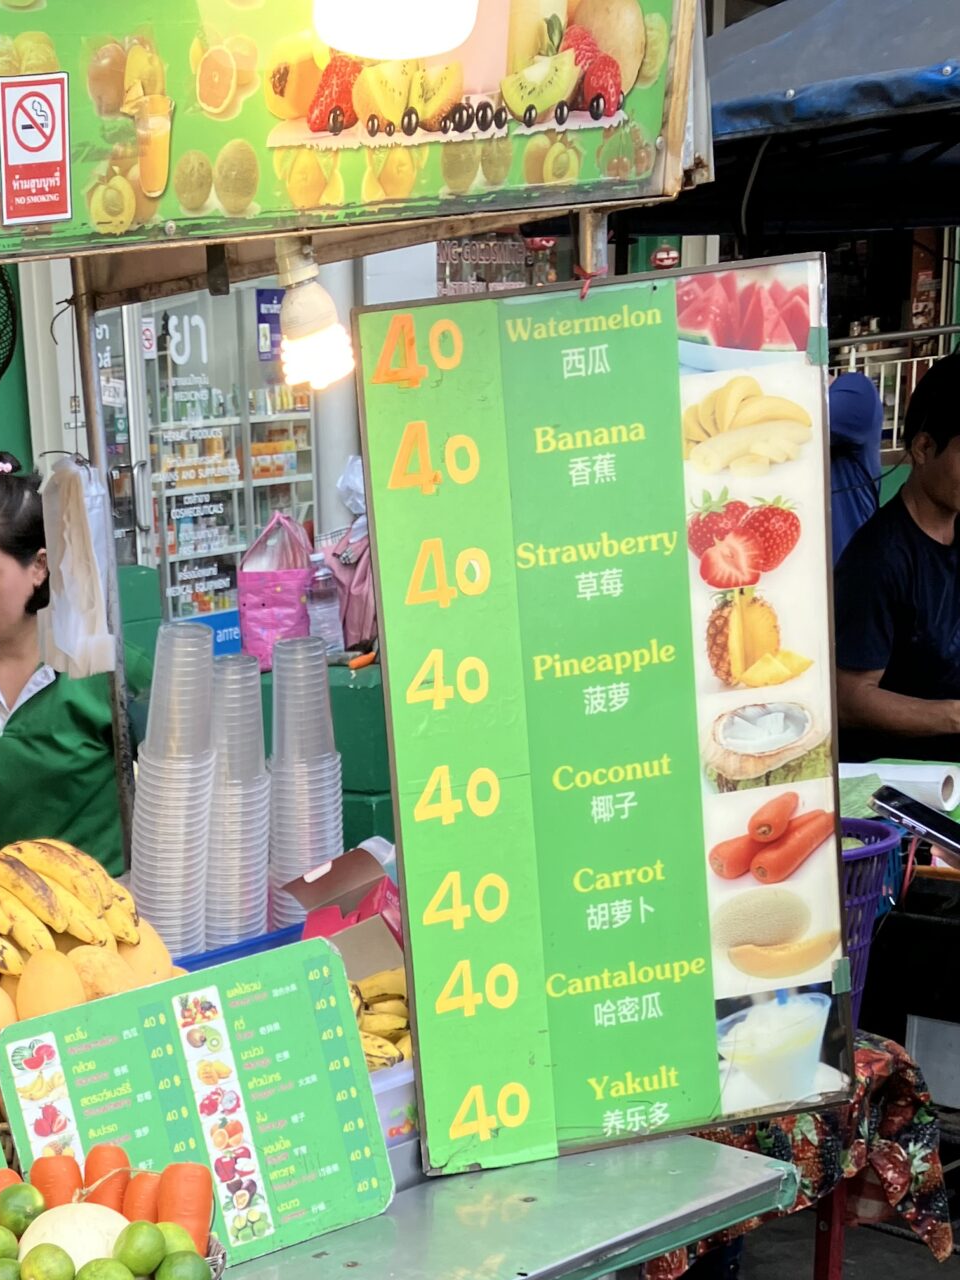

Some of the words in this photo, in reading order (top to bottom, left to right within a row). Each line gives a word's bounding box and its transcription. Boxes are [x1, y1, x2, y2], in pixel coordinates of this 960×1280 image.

[12, 167, 61, 193] ห้ามสูบบุหรี่
[15, 196, 26, 205] NO
[26, 193, 60, 204] SMOKING
[168, 315, 208, 365] ยา
[505, 305, 662, 343] Watermelon
[371, 313, 463, 388] 40
[561, 344, 611, 379] 西瓜
[534, 422, 646, 454] Banana
[387, 420, 480, 495] 40
[568, 453, 617, 487] 香蕉
[515, 531, 678, 569] Strawberry
[405, 538, 491, 608] 40
[575, 568, 624, 601] 草莓
[533, 638, 676, 681] Pineapple
[406, 648, 489, 710] 40
[583, 682, 630, 715] 菠萝
[552, 753, 672, 791] Coconut
[414, 765, 500, 825] 40
[590, 791, 638, 823] 椰子
[573, 860, 666, 893] Carrot
[423, 871, 509, 930] 40
[586, 896, 655, 931] 胡萝卜
[308, 968, 320, 981] 40
[435, 960, 518, 1016] 40
[546, 957, 706, 998] Cantaloupe
[315, 998, 327, 1010] 40
[594, 992, 663, 1028] 哈密瓜
[144, 1015, 156, 1028] 40
[321, 1029, 334, 1041] 40
[150, 1047, 163, 1059] 40
[329, 1059, 341, 1071] 40
[158, 1078, 171, 1090] 40
[336, 1090, 348, 1102] 40
[587, 1065, 680, 1101] Yakult
[166, 1109, 178, 1122] 40
[343, 1121, 355, 1132] 40
[449, 1082, 530, 1141] 40
[602, 1102, 671, 1138] 养乐多
[173, 1141, 186, 1153] 40
[350, 1149, 362, 1161] 40
[357, 1180, 369, 1192] 40
